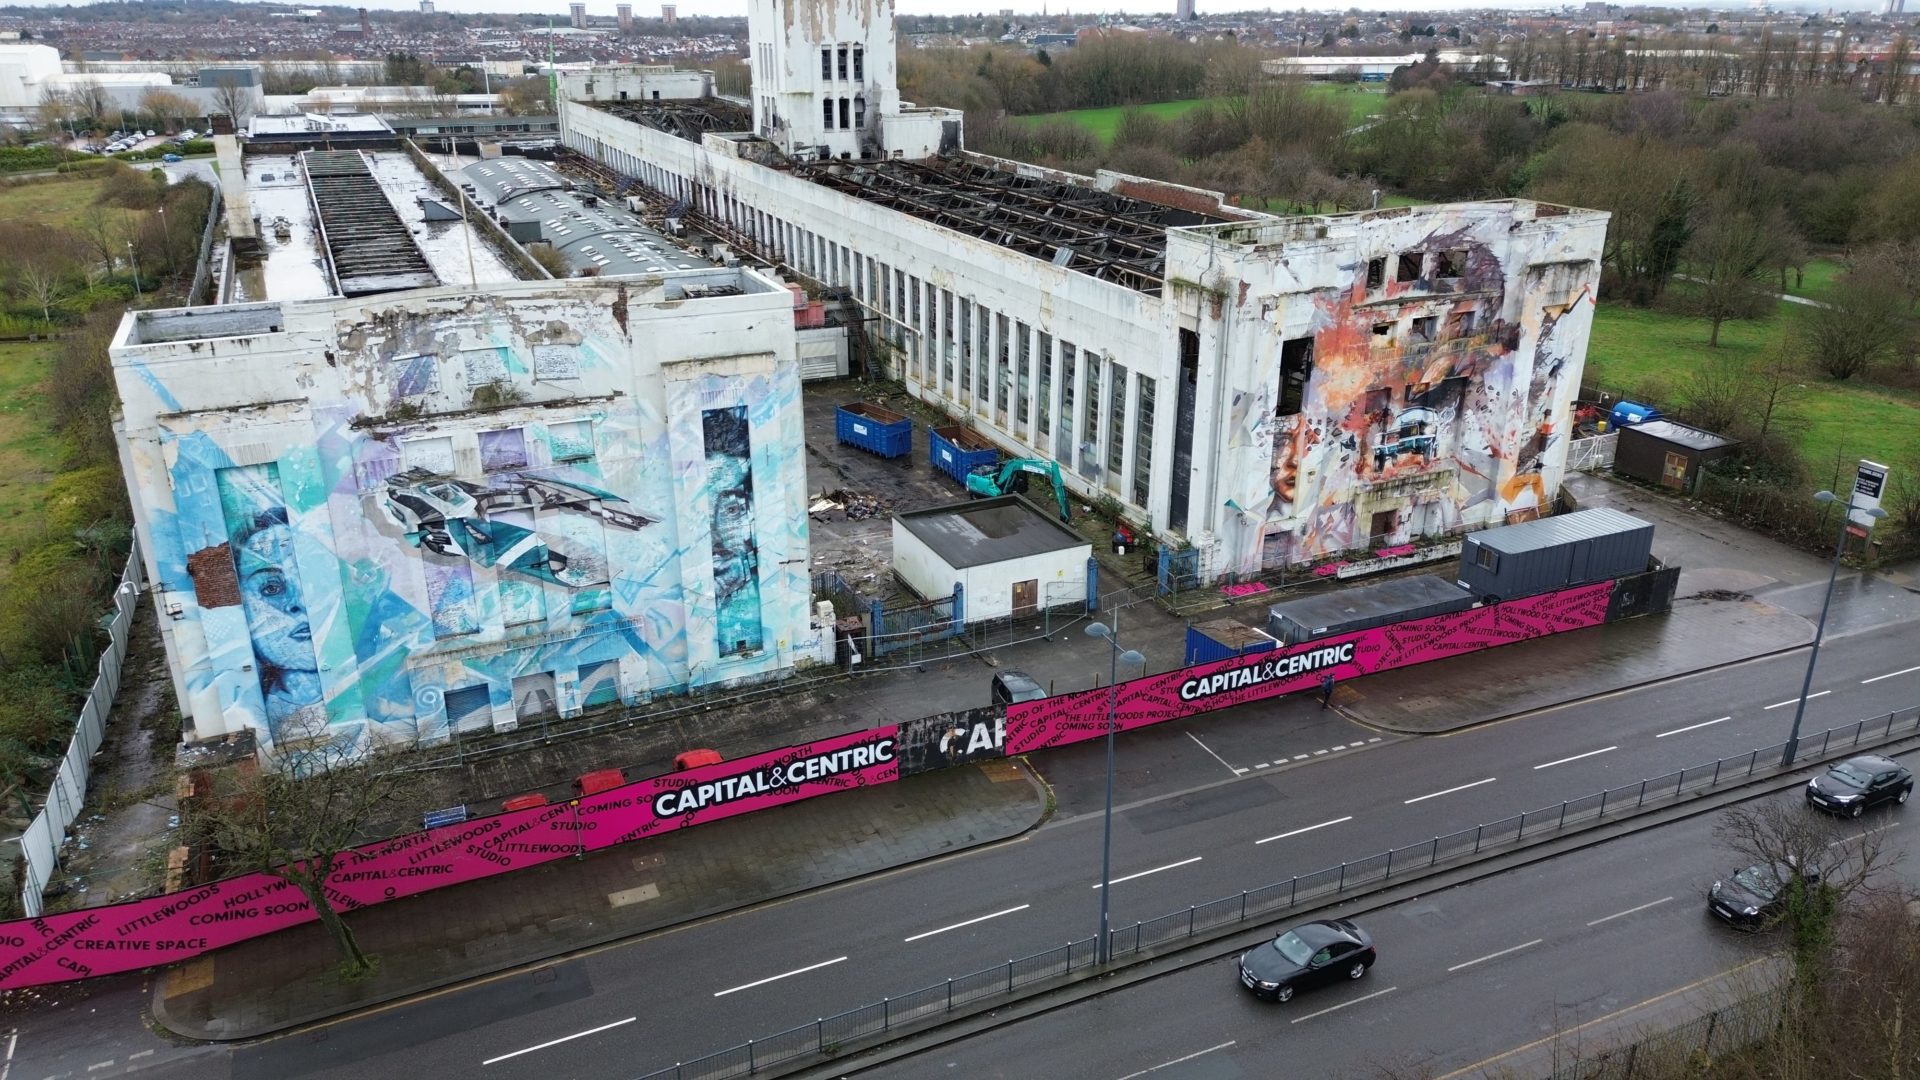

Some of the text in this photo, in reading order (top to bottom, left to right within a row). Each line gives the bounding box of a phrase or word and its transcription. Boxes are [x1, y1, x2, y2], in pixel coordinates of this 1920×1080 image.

[1501, 604, 1541, 619] HOLLYWOOD
[1391, 624, 1447, 633] COMING SOON
[1181, 643, 1354, 700] CAPITAL&CENTRIC
[1030, 688, 1111, 728] CAPITAL&CENTRIC
[1031, 703, 1045, 715] OF
[1048, 697, 1065, 708] THE
[1055, 722, 1095, 731] COMING
[1065, 713, 1081, 722] THE
[1013, 724, 1047, 752] STUDIO
[655, 739, 894, 816] CAPITAL&CENTRIC
[577, 799, 632, 816] COMING
[551, 821, 597, 831] STUDIO
[408, 819, 502, 865] LITTLEWOODS
[466, 844, 512, 867] STUDIO
[331, 863, 454, 884] CAPITAL&CENTRIC
[116, 884, 221, 936] LITTLEWOODS
[189, 901, 310, 926] COMING SOON
[73, 937, 207, 951] CREATIVE SPACE
